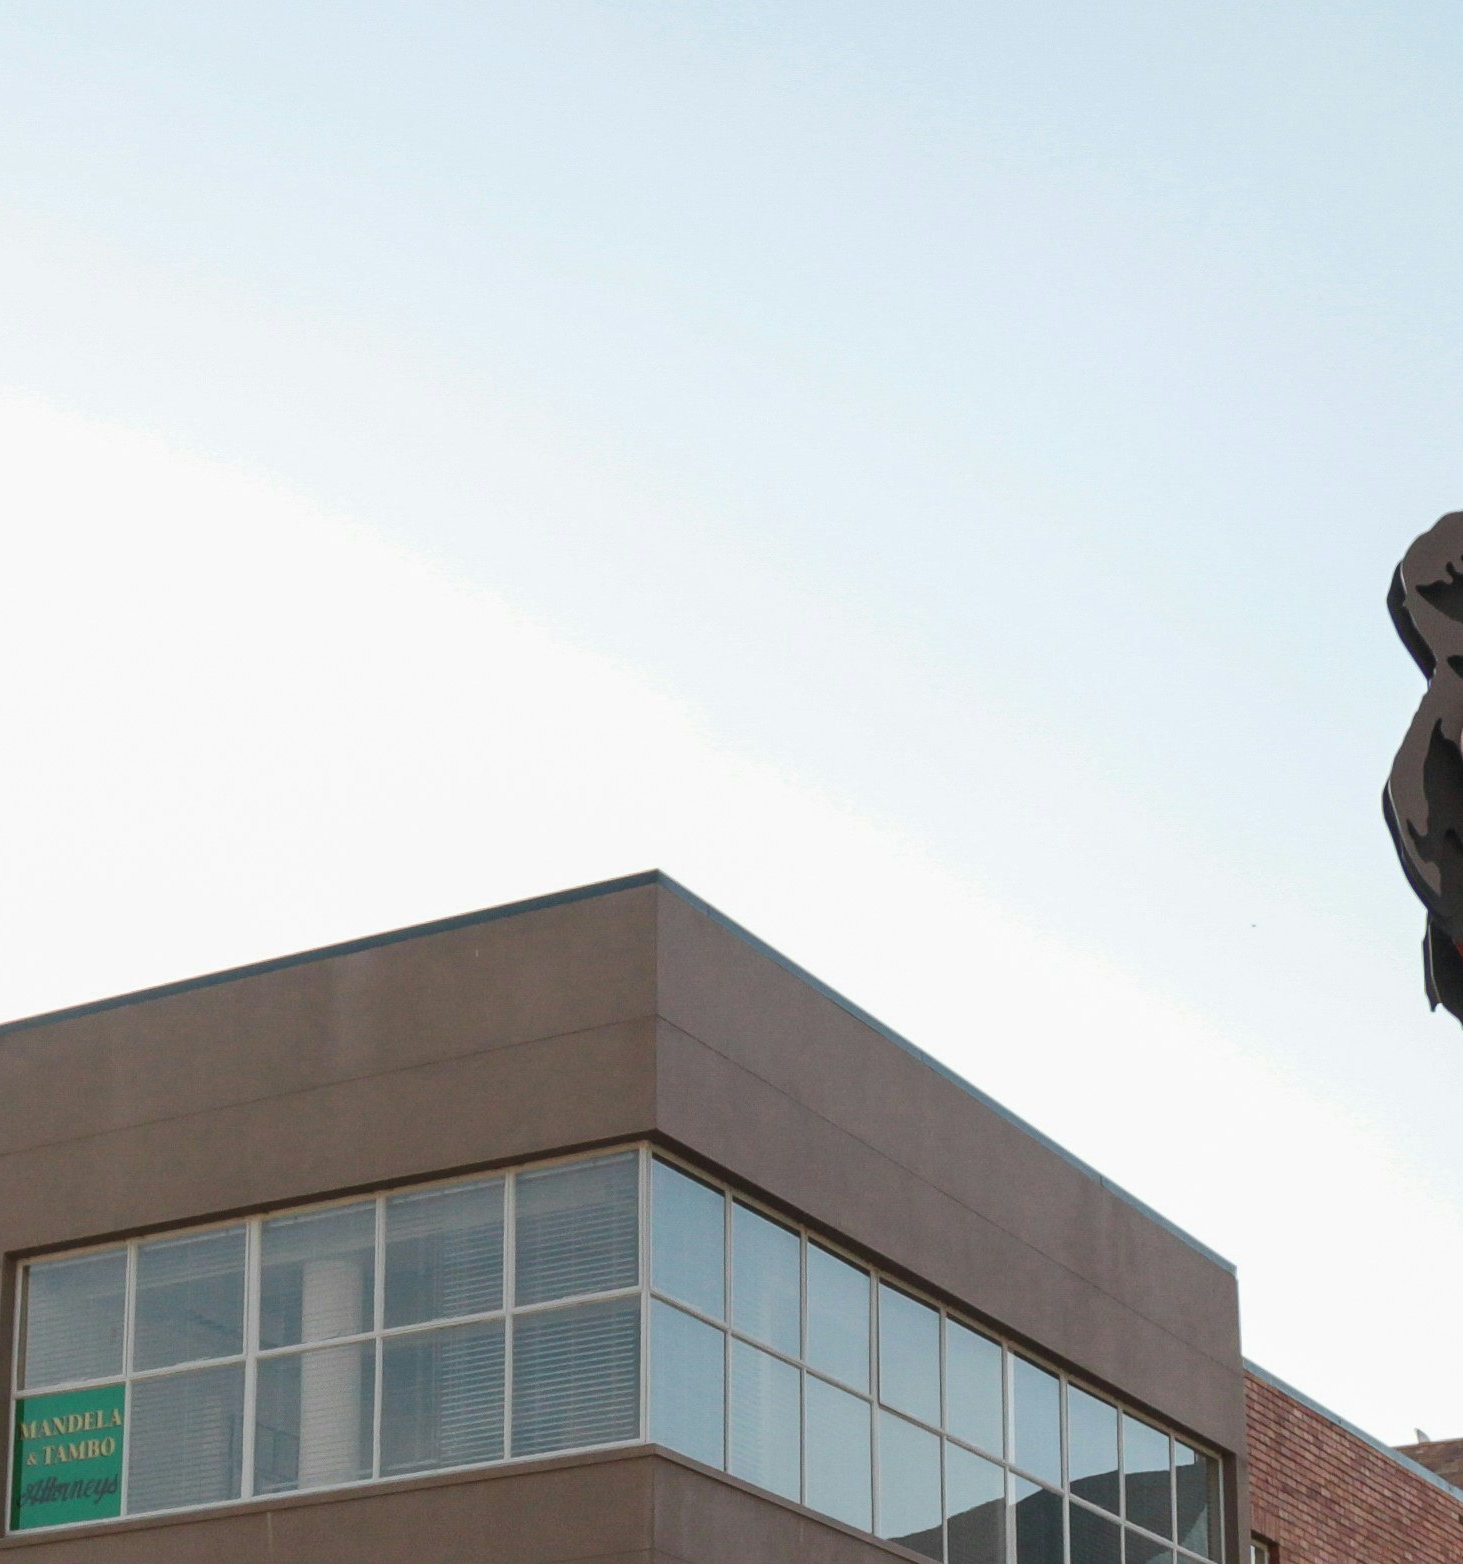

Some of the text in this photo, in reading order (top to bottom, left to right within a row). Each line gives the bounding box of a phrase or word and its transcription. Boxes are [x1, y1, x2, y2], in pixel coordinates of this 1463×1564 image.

[20, 1408, 122, 1440] MANDELA
[26, 1436, 116, 1467] & TAMBO
[18, 1474, 119, 1508] Attorneys
